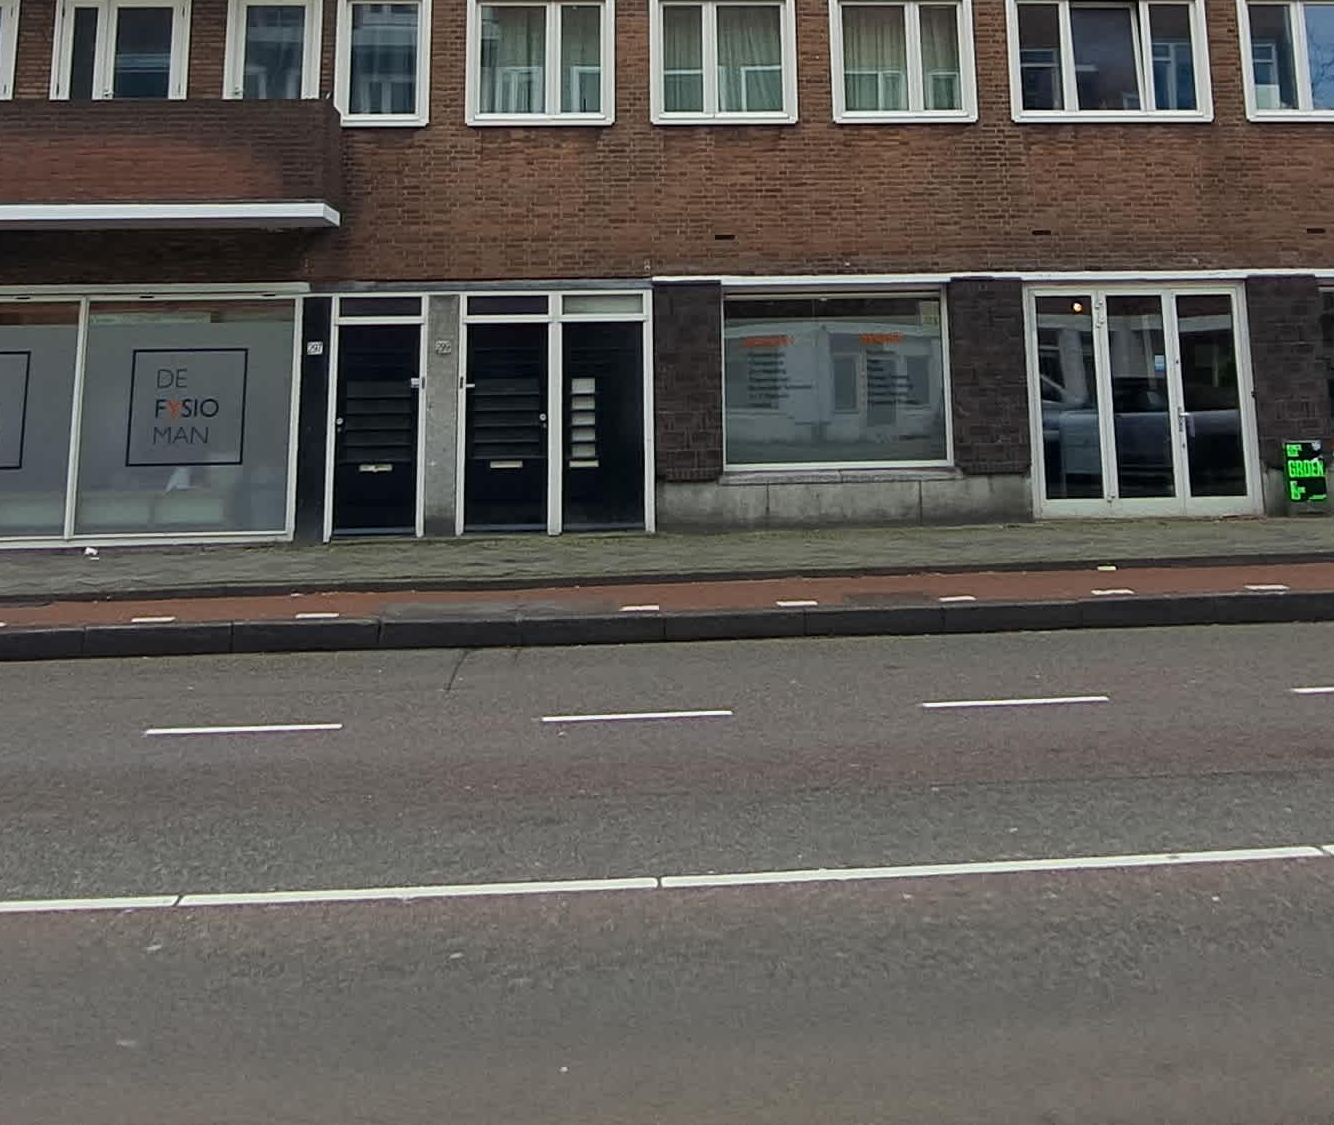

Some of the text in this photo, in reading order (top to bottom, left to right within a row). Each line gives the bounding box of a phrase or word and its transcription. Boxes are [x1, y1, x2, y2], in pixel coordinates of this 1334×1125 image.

[156, 368, 188, 388] DE
[155, 398, 219, 418] FYSIO
[152, 426, 209, 444] MAN
